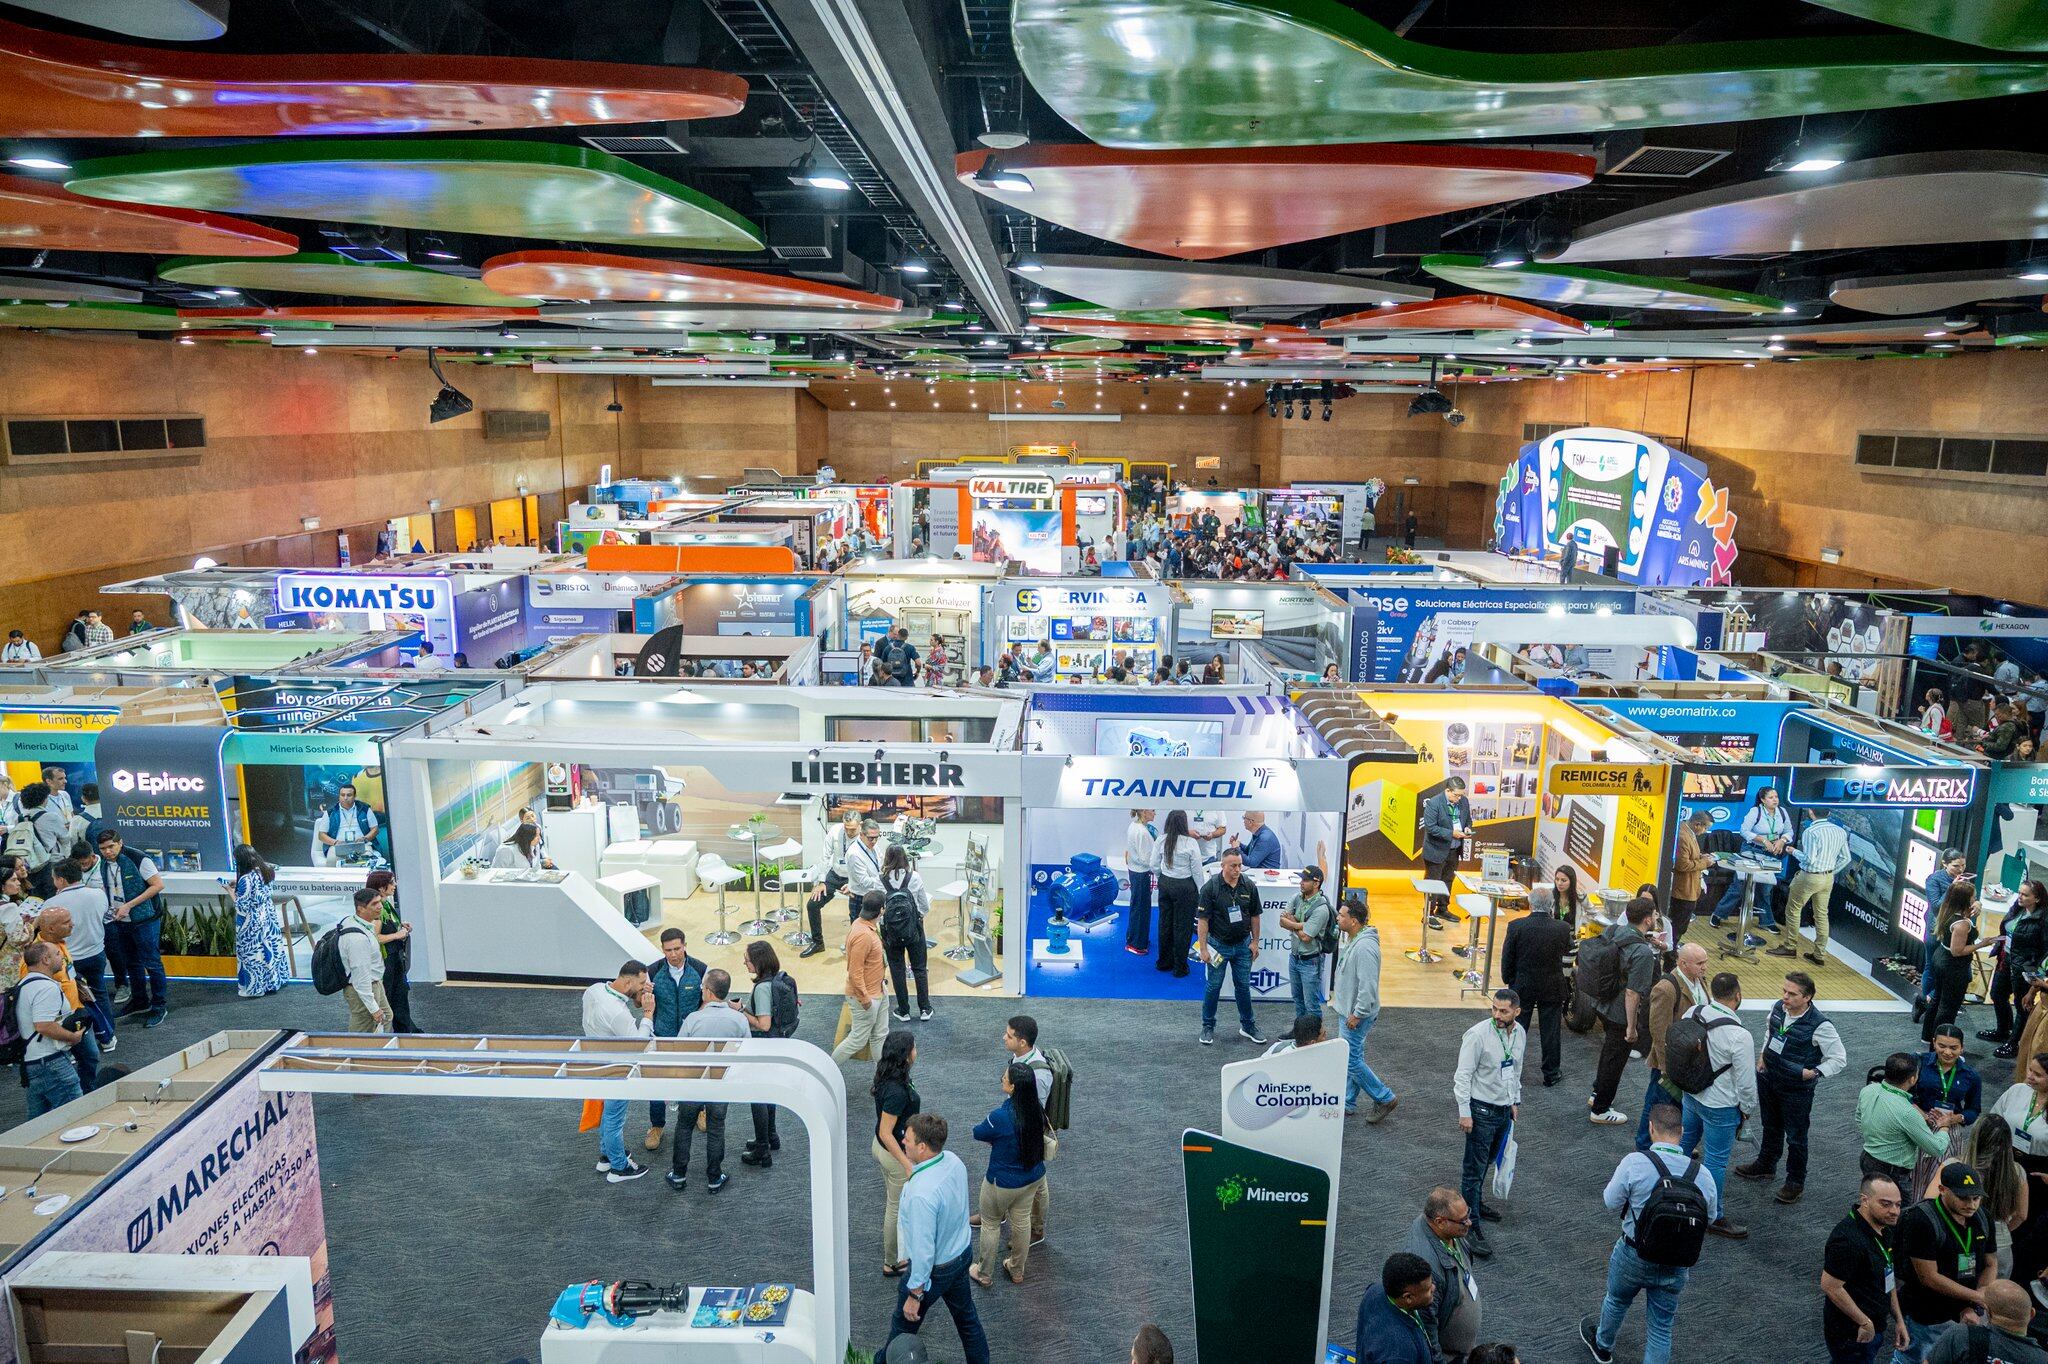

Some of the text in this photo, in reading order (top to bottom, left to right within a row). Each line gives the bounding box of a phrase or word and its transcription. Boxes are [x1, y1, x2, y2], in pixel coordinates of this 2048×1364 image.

[555, 583, 591, 592] BRISTOL
[291, 583, 436, 610] KOMATSU
[915, 596, 934, 605] Coal
[936, 597, 971, 609] Analyzer
[1415, 599, 1461, 609] Soluciones
[1462, 600, 1503, 610] Eléctricas
[1568, 603, 1589, 612] para
[278, 619, 296, 629] HELIX
[1447, 618, 1471, 626] Cables
[275, 692, 303, 706] Hoy
[1628, 706, 1737, 718] www.geomatrix.co
[50, 743, 79, 752] Digital
[305, 745, 354, 754] Sostenible
[1840, 737, 1884, 764] GEOMATRIX
[792, 761, 966, 787] LIEBHERR
[1560, 770, 1628, 783] REMICSA
[136, 771, 205, 796] Epiroc
[1081, 778, 1253, 799] TRAINCOL
[1846, 777, 1970, 798] GEOMATRIX
[2029, 787, 2037, 797] &
[117, 805, 210, 818] ACCELERATE
[117, 819, 134, 827] THE
[1626, 822, 1636, 837] POST
[1627, 812, 1651, 836] SERVICIO
[1845, 900, 1889, 934] HYDROTUBE
[1257, 1082, 1312, 1094] MinExpo
[1256, 1092, 1339, 1107] Colombia
[157, 1091, 289, 1234] MARECHAL
[232, 1153, 288, 1216] ELECTRICAS
[223, 1230, 230, 1246] 5
[233, 1220, 241, 1236] A
[243, 1185, 277, 1224] HASTA
[305, 1148, 312, 1162] A
[1246, 1187, 1310, 1203] Mineros
